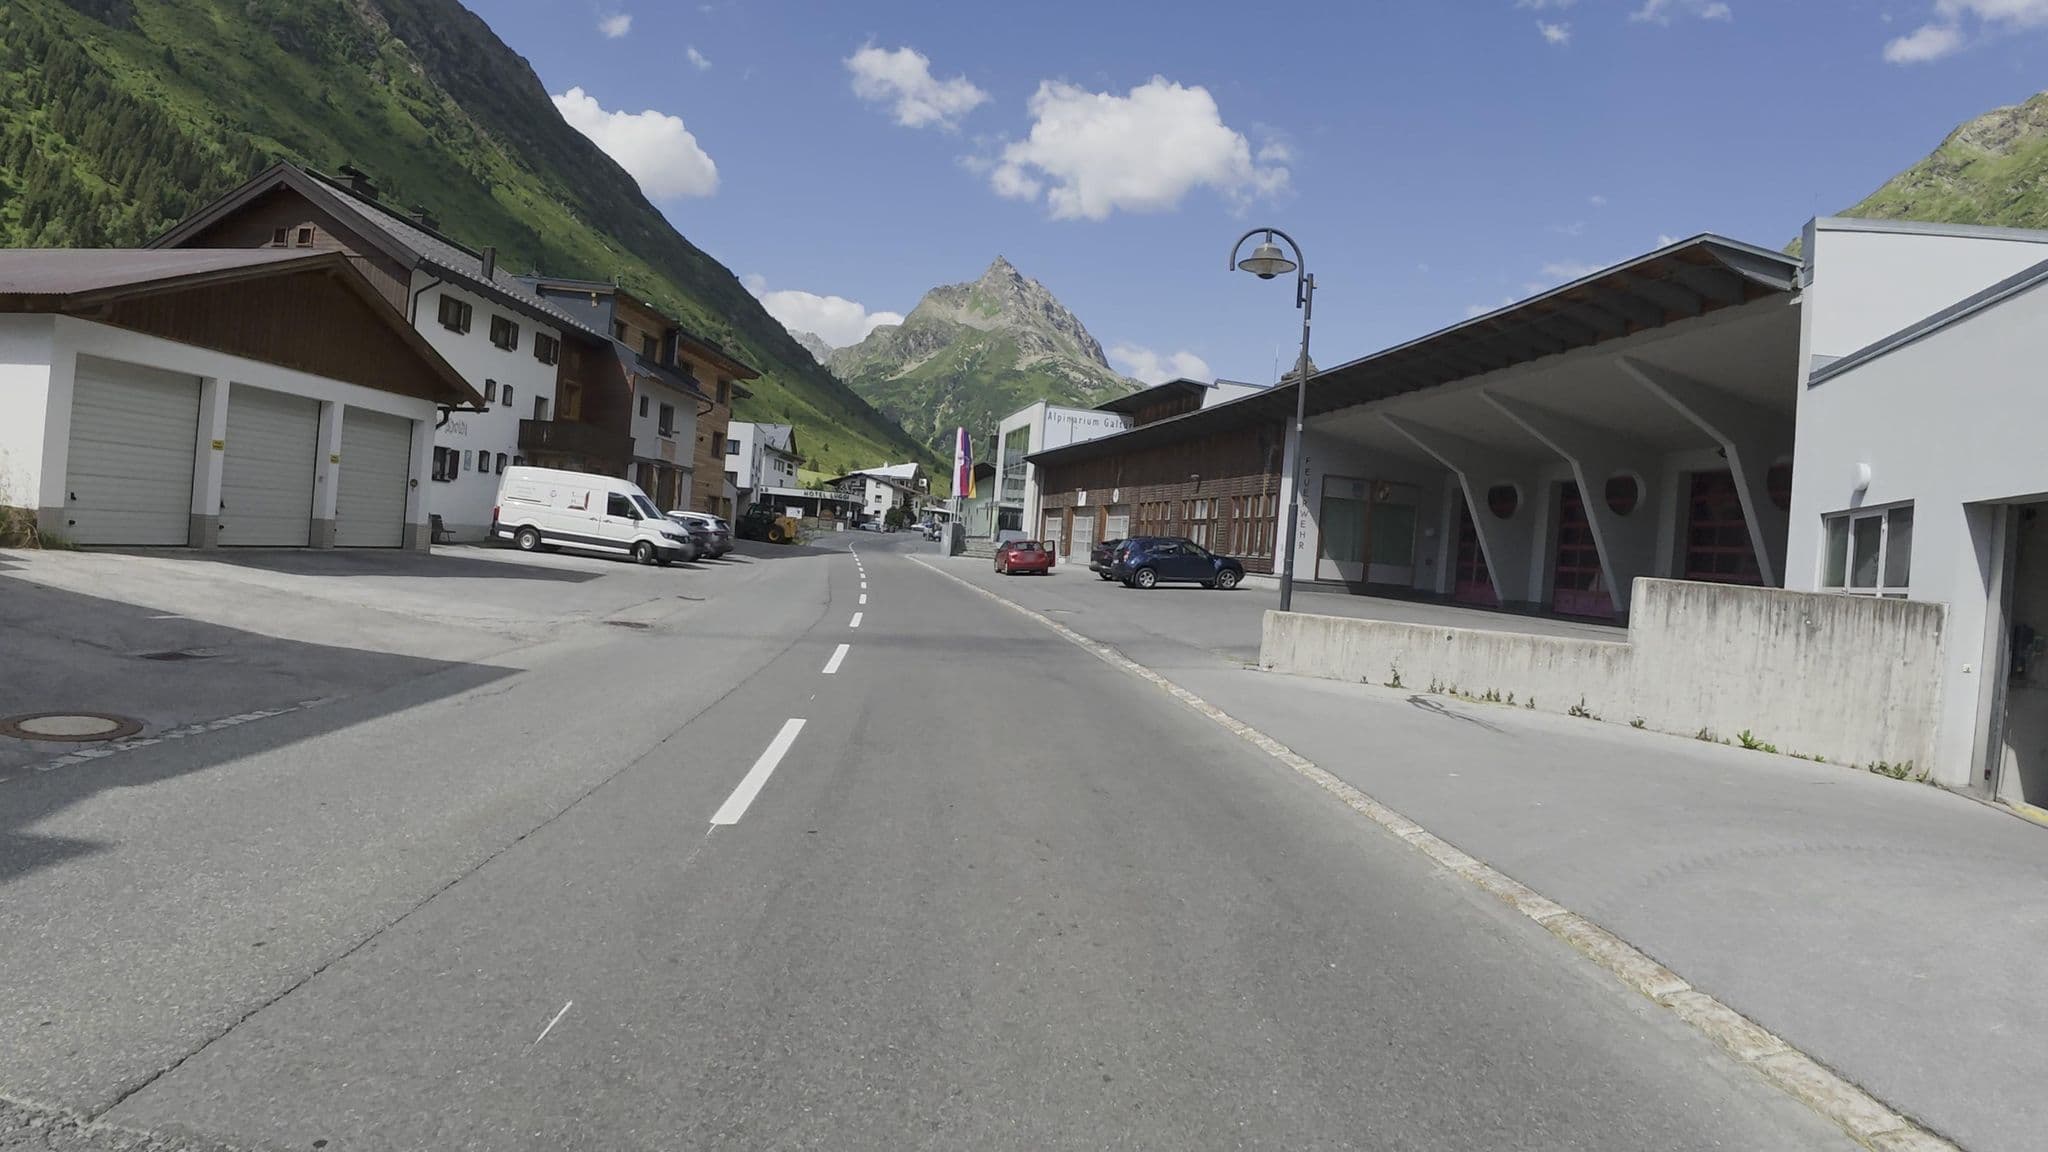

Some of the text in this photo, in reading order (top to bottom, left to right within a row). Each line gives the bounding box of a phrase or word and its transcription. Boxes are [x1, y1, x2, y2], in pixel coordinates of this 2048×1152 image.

[1047, 411, 1100, 427] Alpinarium
[803, 490, 826, 498] HOTEL
[1298, 456, 1311, 549] FEUERWEHR
